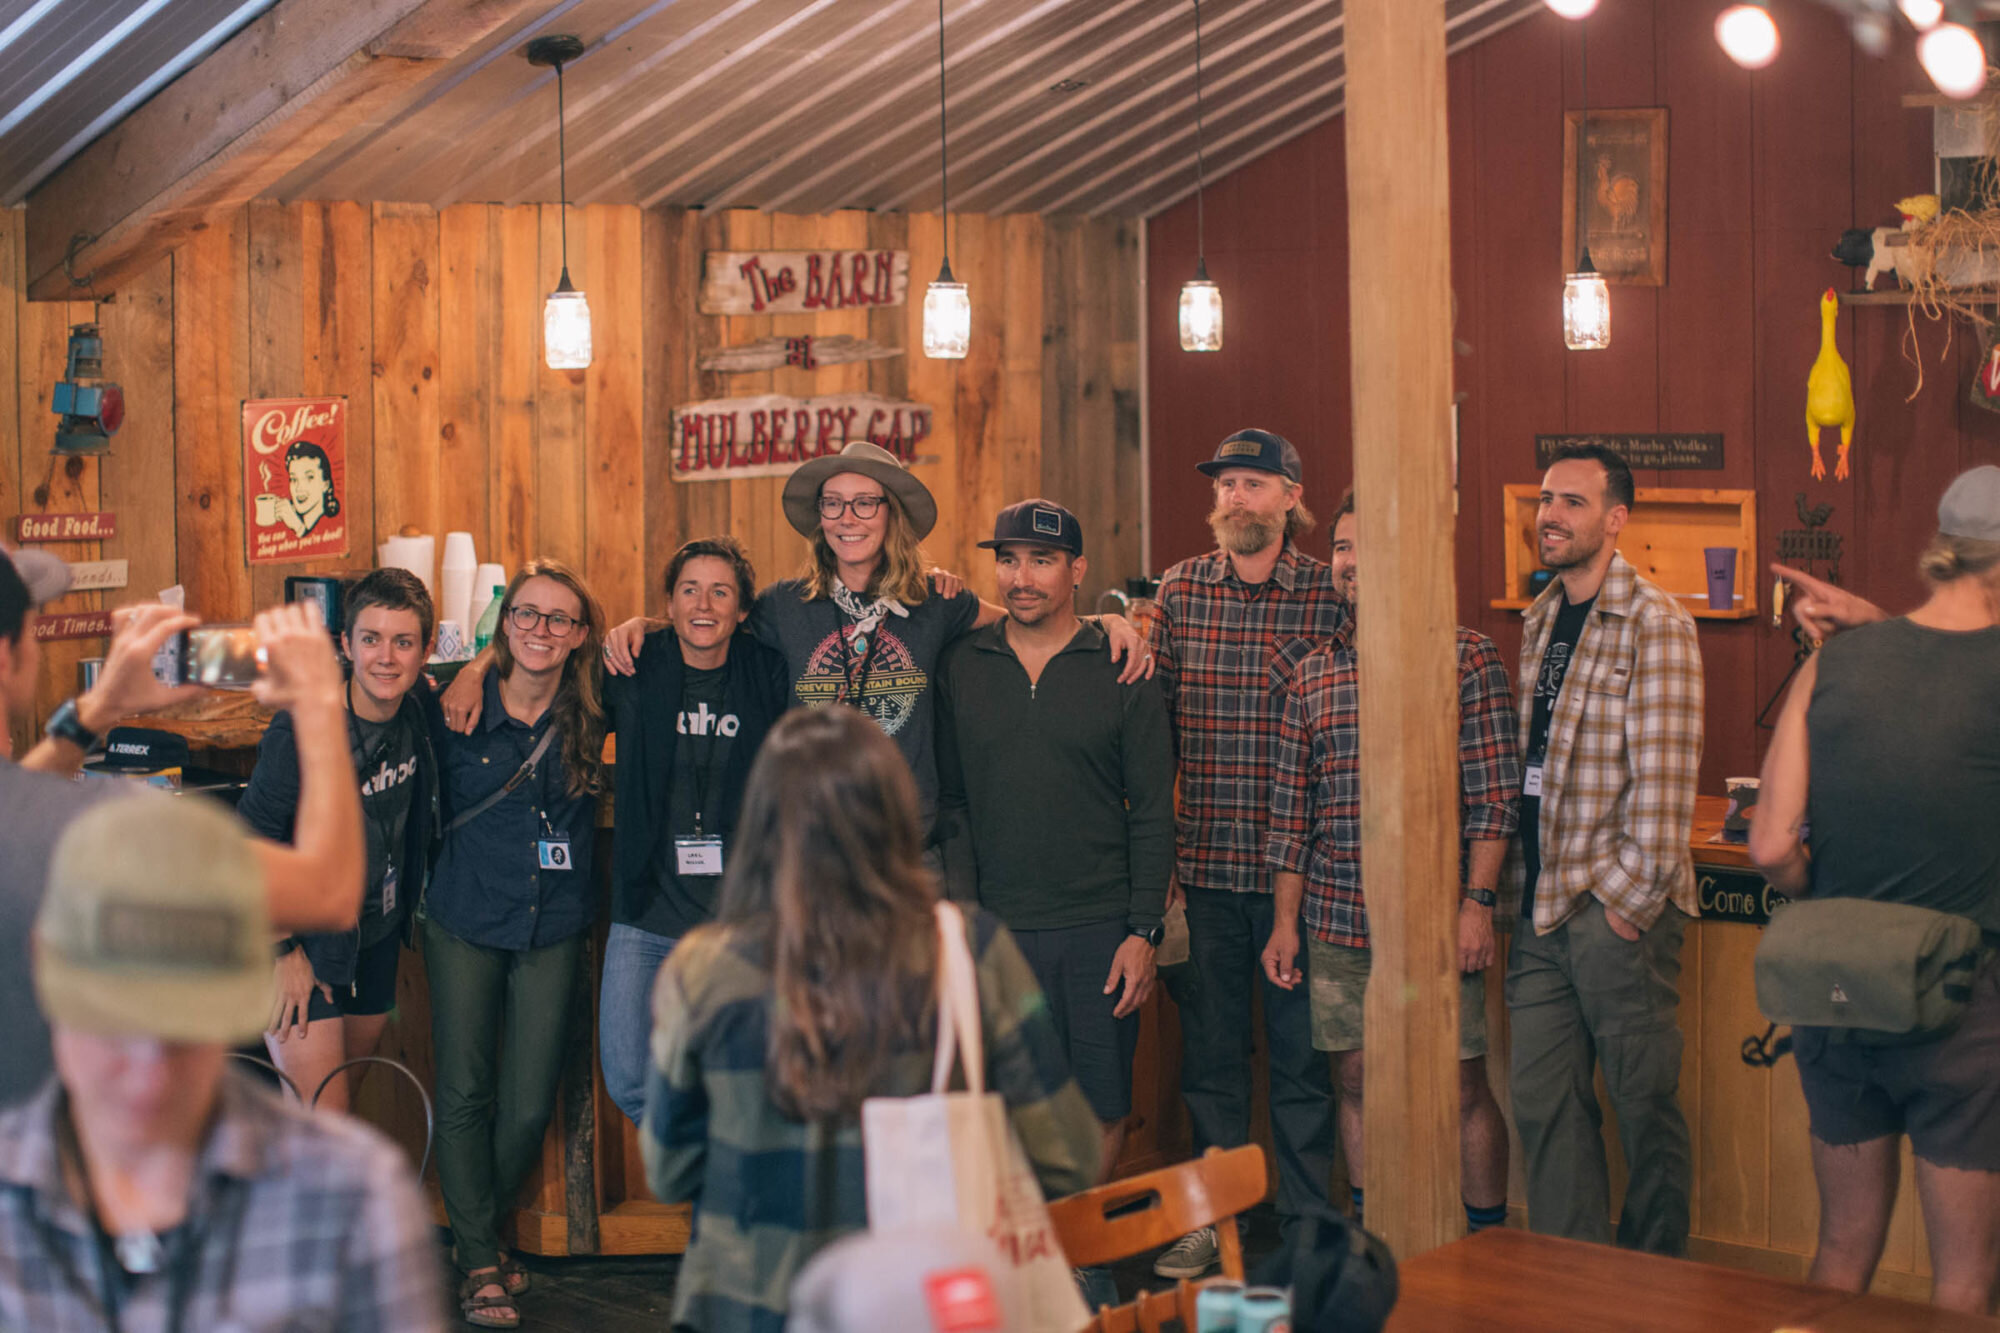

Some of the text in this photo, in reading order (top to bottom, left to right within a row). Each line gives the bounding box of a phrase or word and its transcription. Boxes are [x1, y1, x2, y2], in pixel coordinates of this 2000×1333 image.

[740, 252, 894, 312] The BARN
[252, 404, 339, 455] Coffee!
[675, 407, 858, 472] MULBERRY
[1673, 439, 1708, 451] Vodka
[22, 516, 115, 538] Good Food...
[795, 683, 836, 692] FOREVER
[1699, 876, 1755, 915] Come
